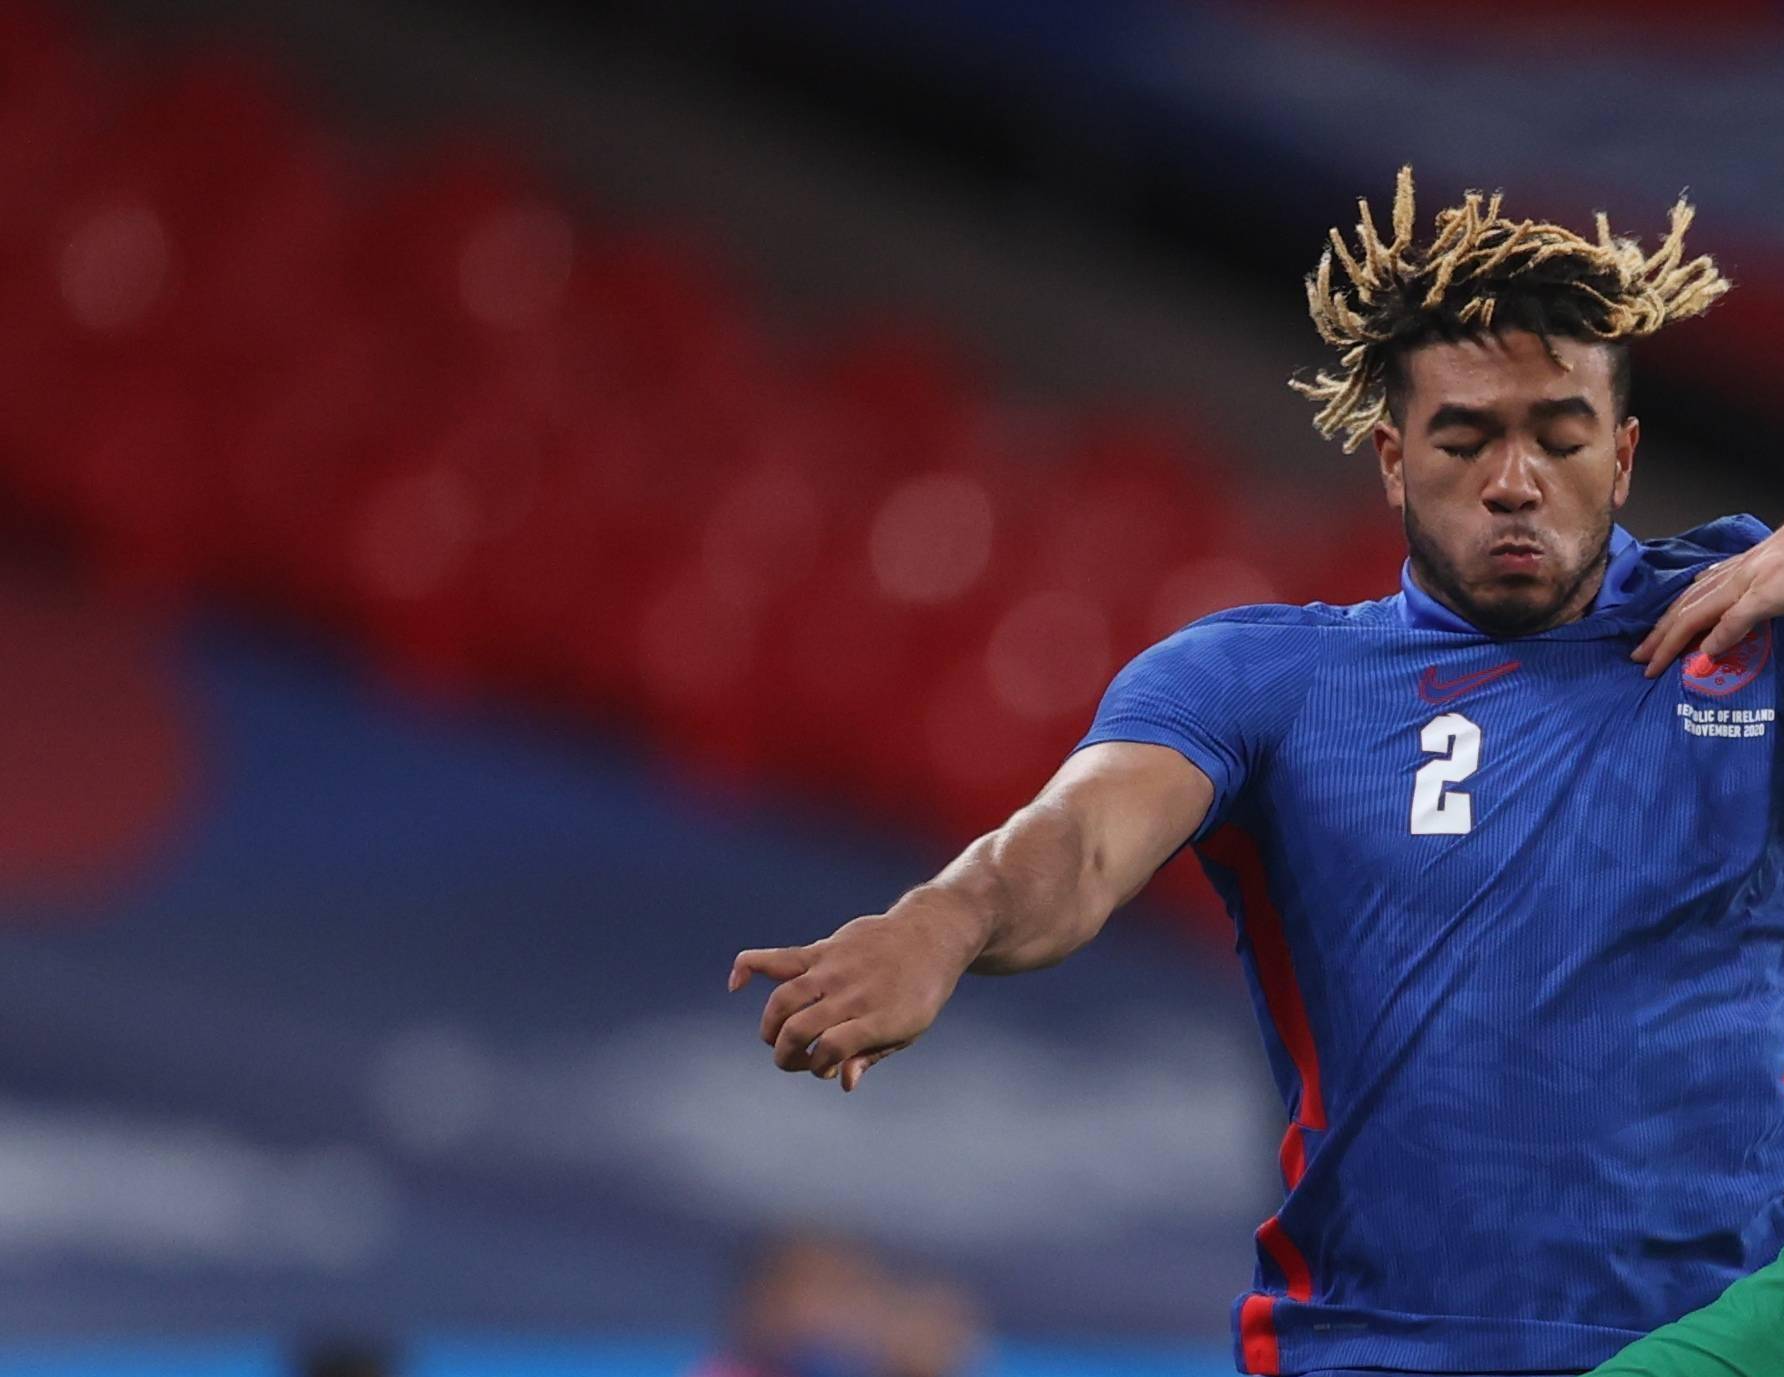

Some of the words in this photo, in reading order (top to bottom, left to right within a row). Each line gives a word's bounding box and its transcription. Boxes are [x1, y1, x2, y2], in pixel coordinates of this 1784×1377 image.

[1717, 710, 1730, 722] OF
[1732, 709, 1775, 723] IRELAND
[1743, 723, 1765, 737] 2020
[1411, 713, 1482, 834] 2
